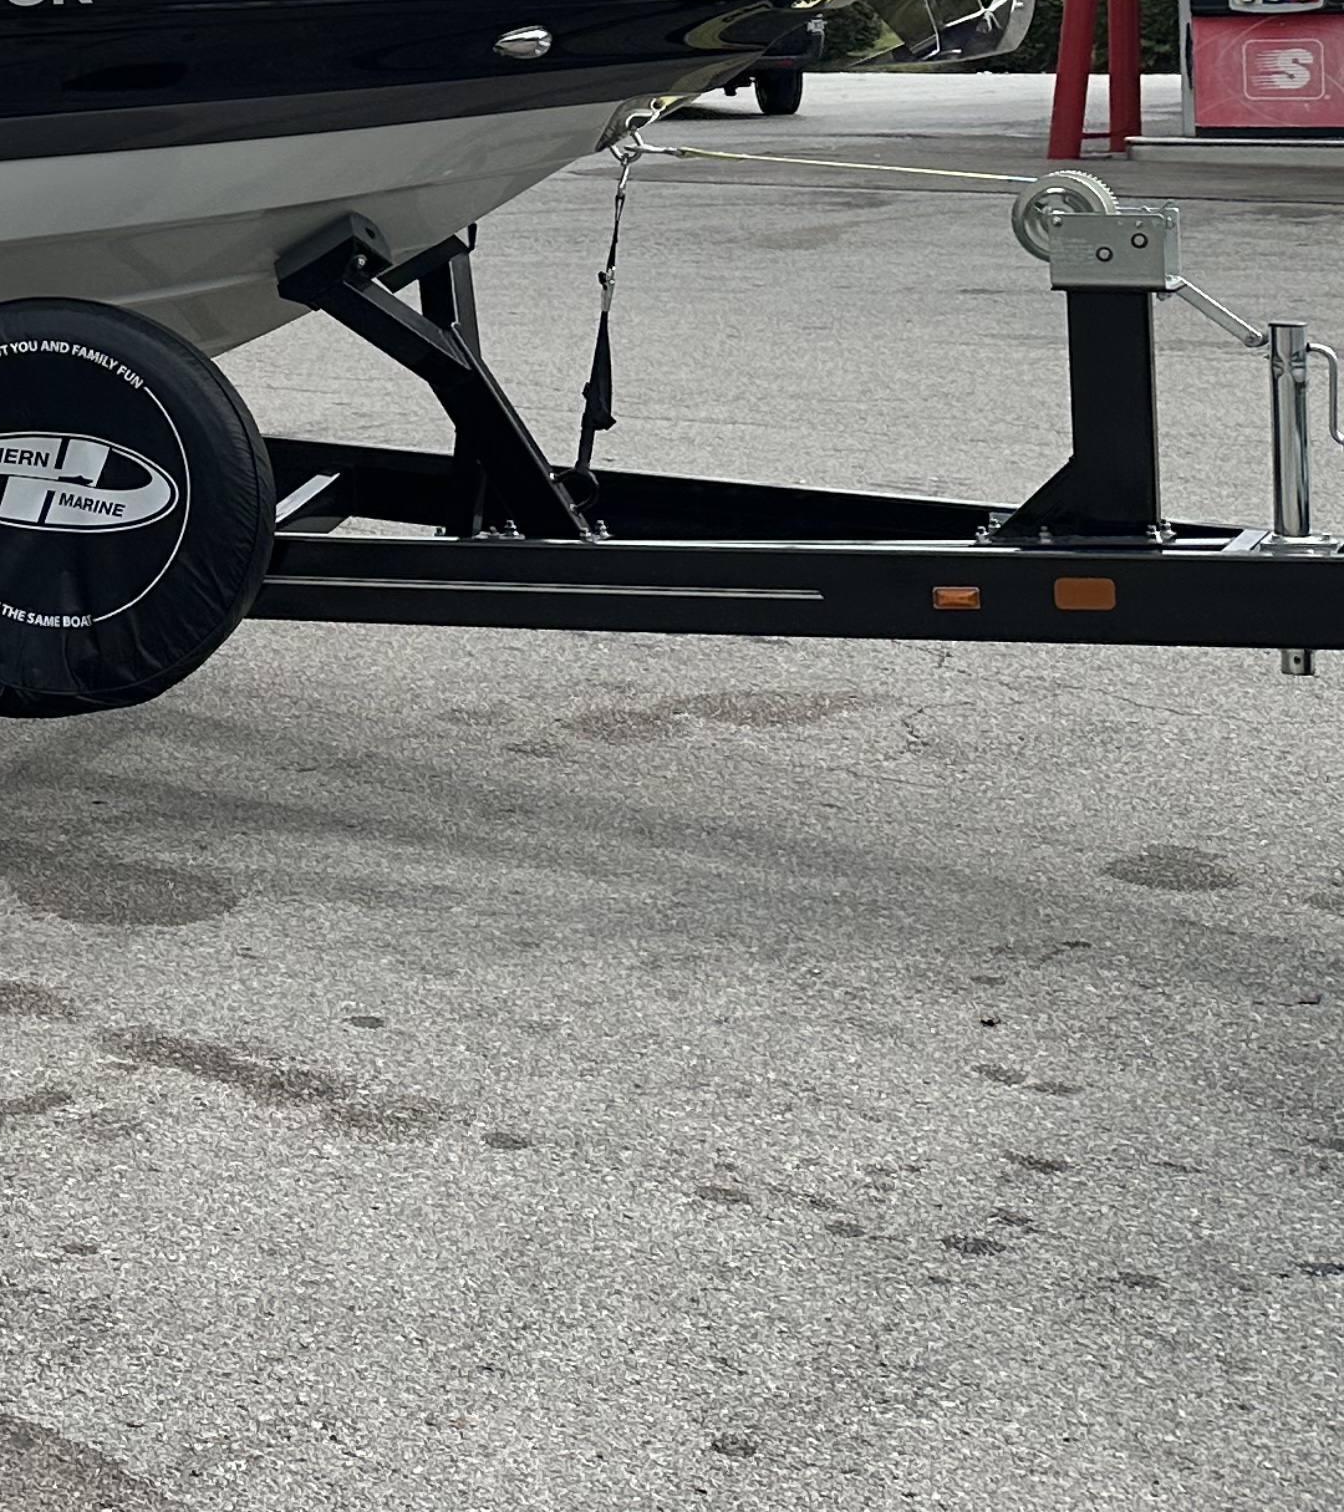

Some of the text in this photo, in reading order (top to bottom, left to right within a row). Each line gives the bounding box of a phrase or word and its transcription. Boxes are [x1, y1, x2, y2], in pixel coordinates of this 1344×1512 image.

[10, 340, 38, 354] YOU
[40, 340, 70, 353] AND
[71, 344, 118, 370] FAMILY
[116, 364, 144, 389] FUN
[58, 492, 126, 517] MARINE
[2, 603, 26, 622] THE
[26, 612, 60, 627] SAME
[62, 614, 92, 628] BOAT
